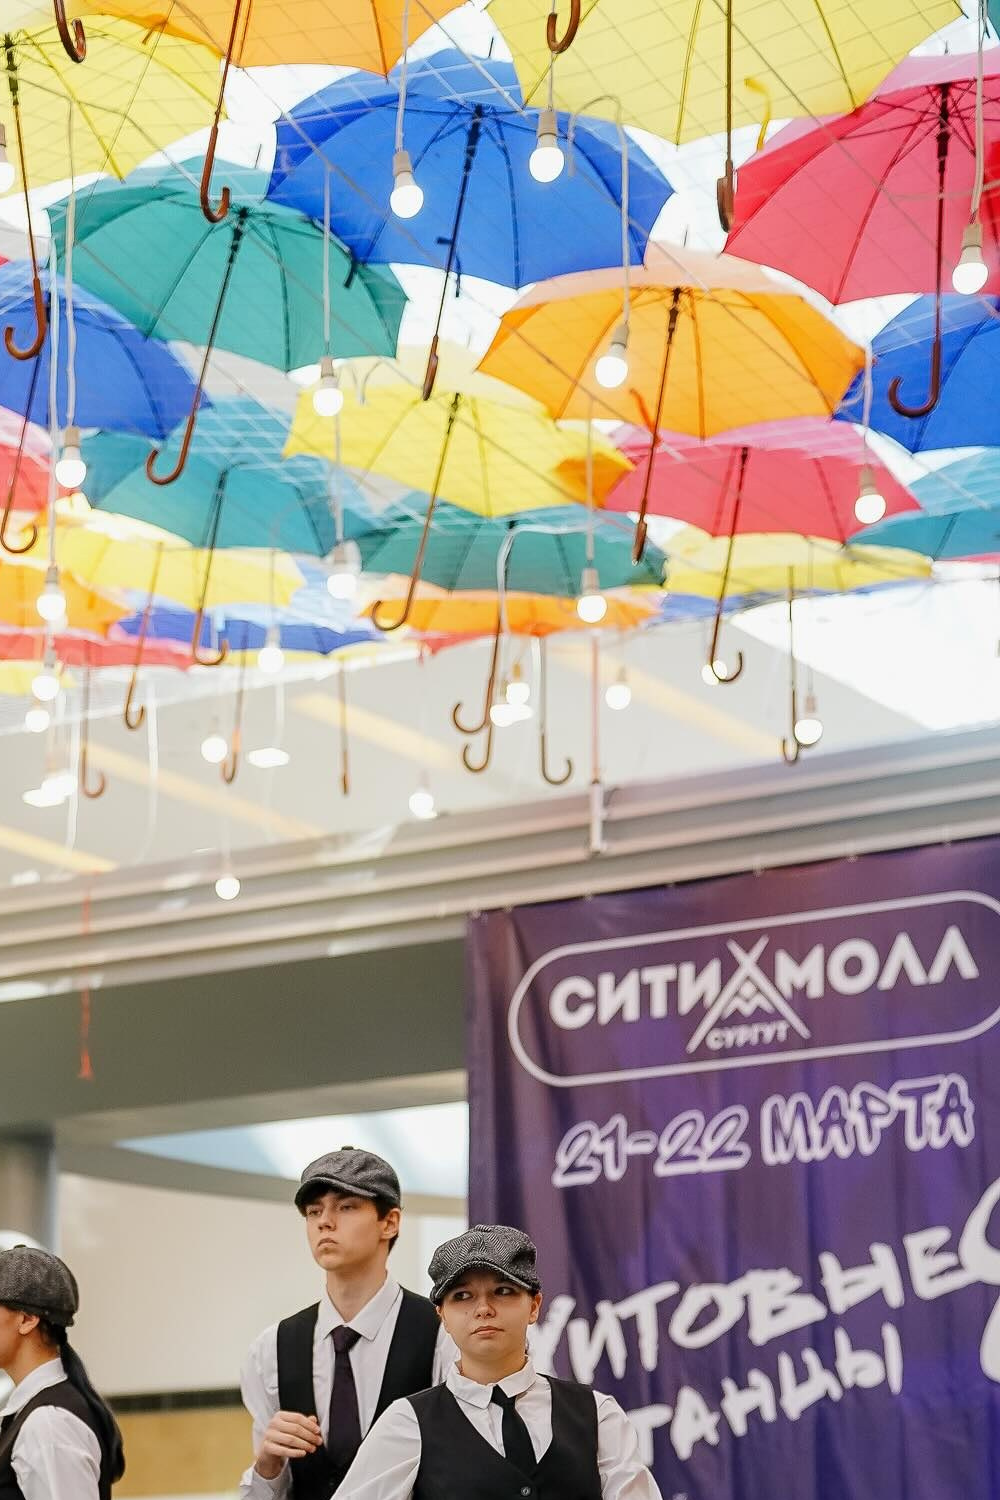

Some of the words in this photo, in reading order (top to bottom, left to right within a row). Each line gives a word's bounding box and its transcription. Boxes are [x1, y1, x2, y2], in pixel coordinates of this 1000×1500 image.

[706, 1019, 791, 1051] СУРГУТ
[551, 1103, 752, 1189] 21-22
[759, 1072, 976, 1167] МАРТА
[627, 1320, 905, 1468] ТАНЦЫ
